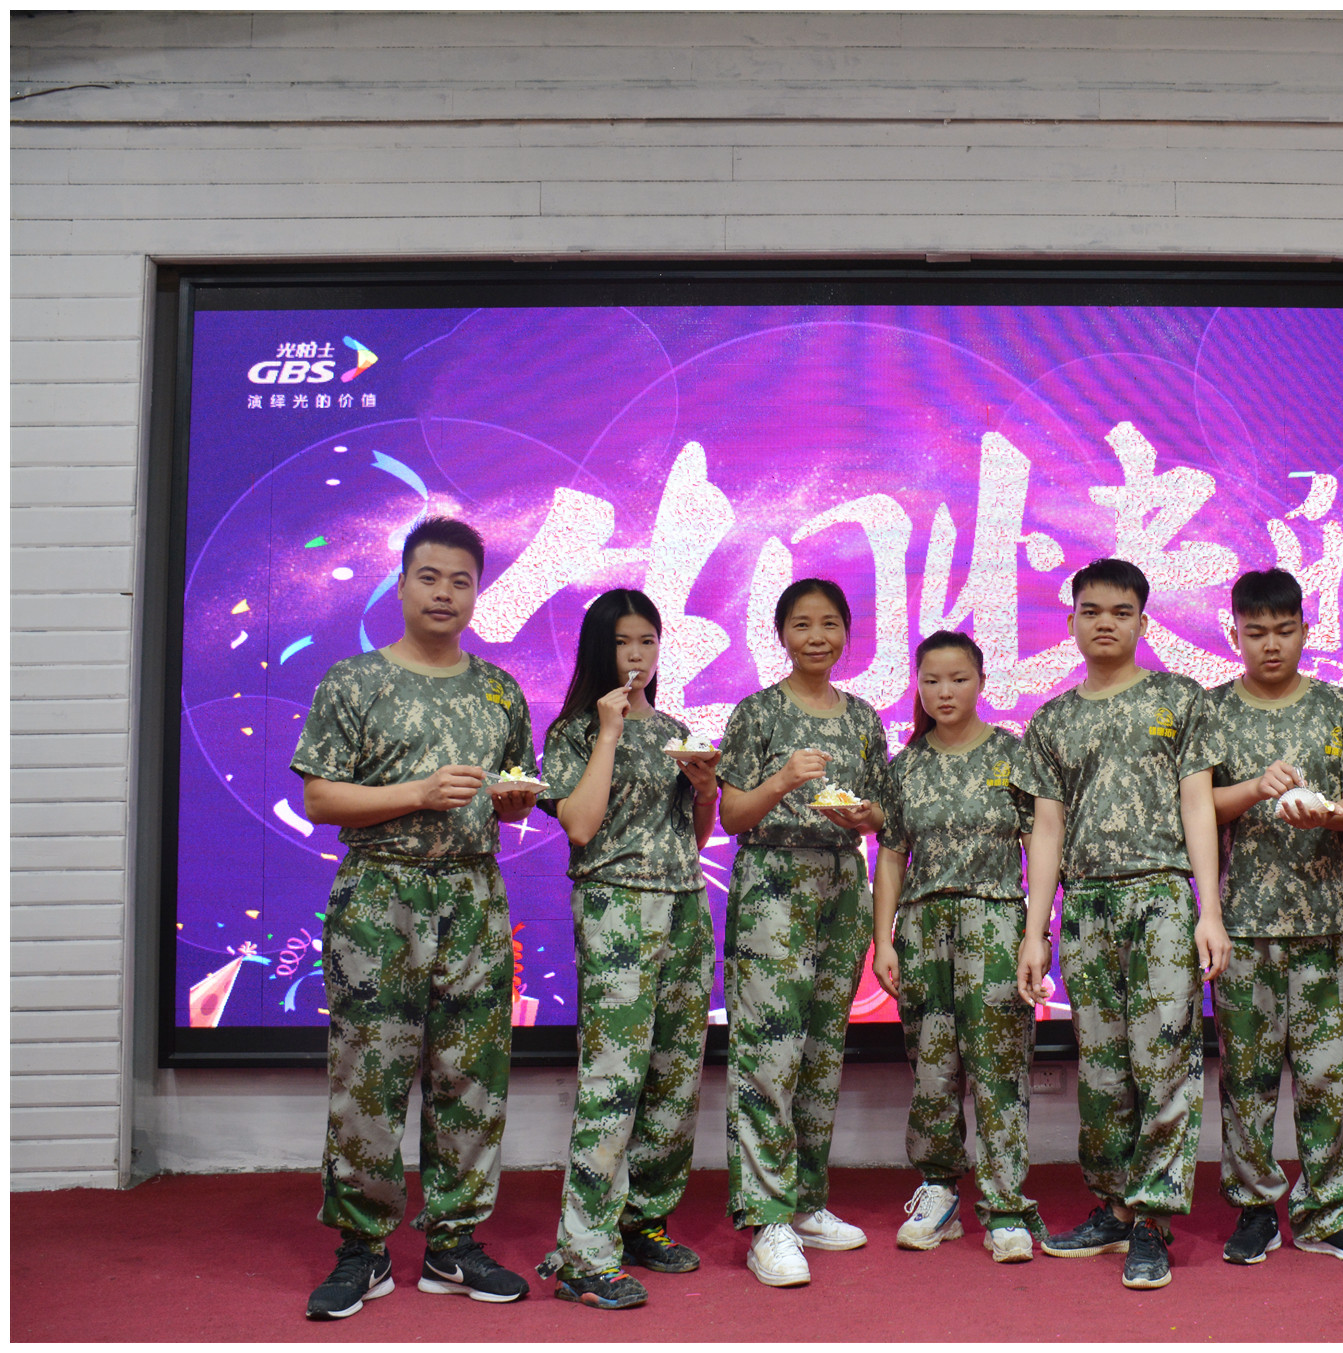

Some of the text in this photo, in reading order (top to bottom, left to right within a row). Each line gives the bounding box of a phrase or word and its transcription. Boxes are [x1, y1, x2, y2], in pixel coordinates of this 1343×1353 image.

[247, 361, 336, 384] GBS
[247, 393, 376, 409] 演绎光的价值
